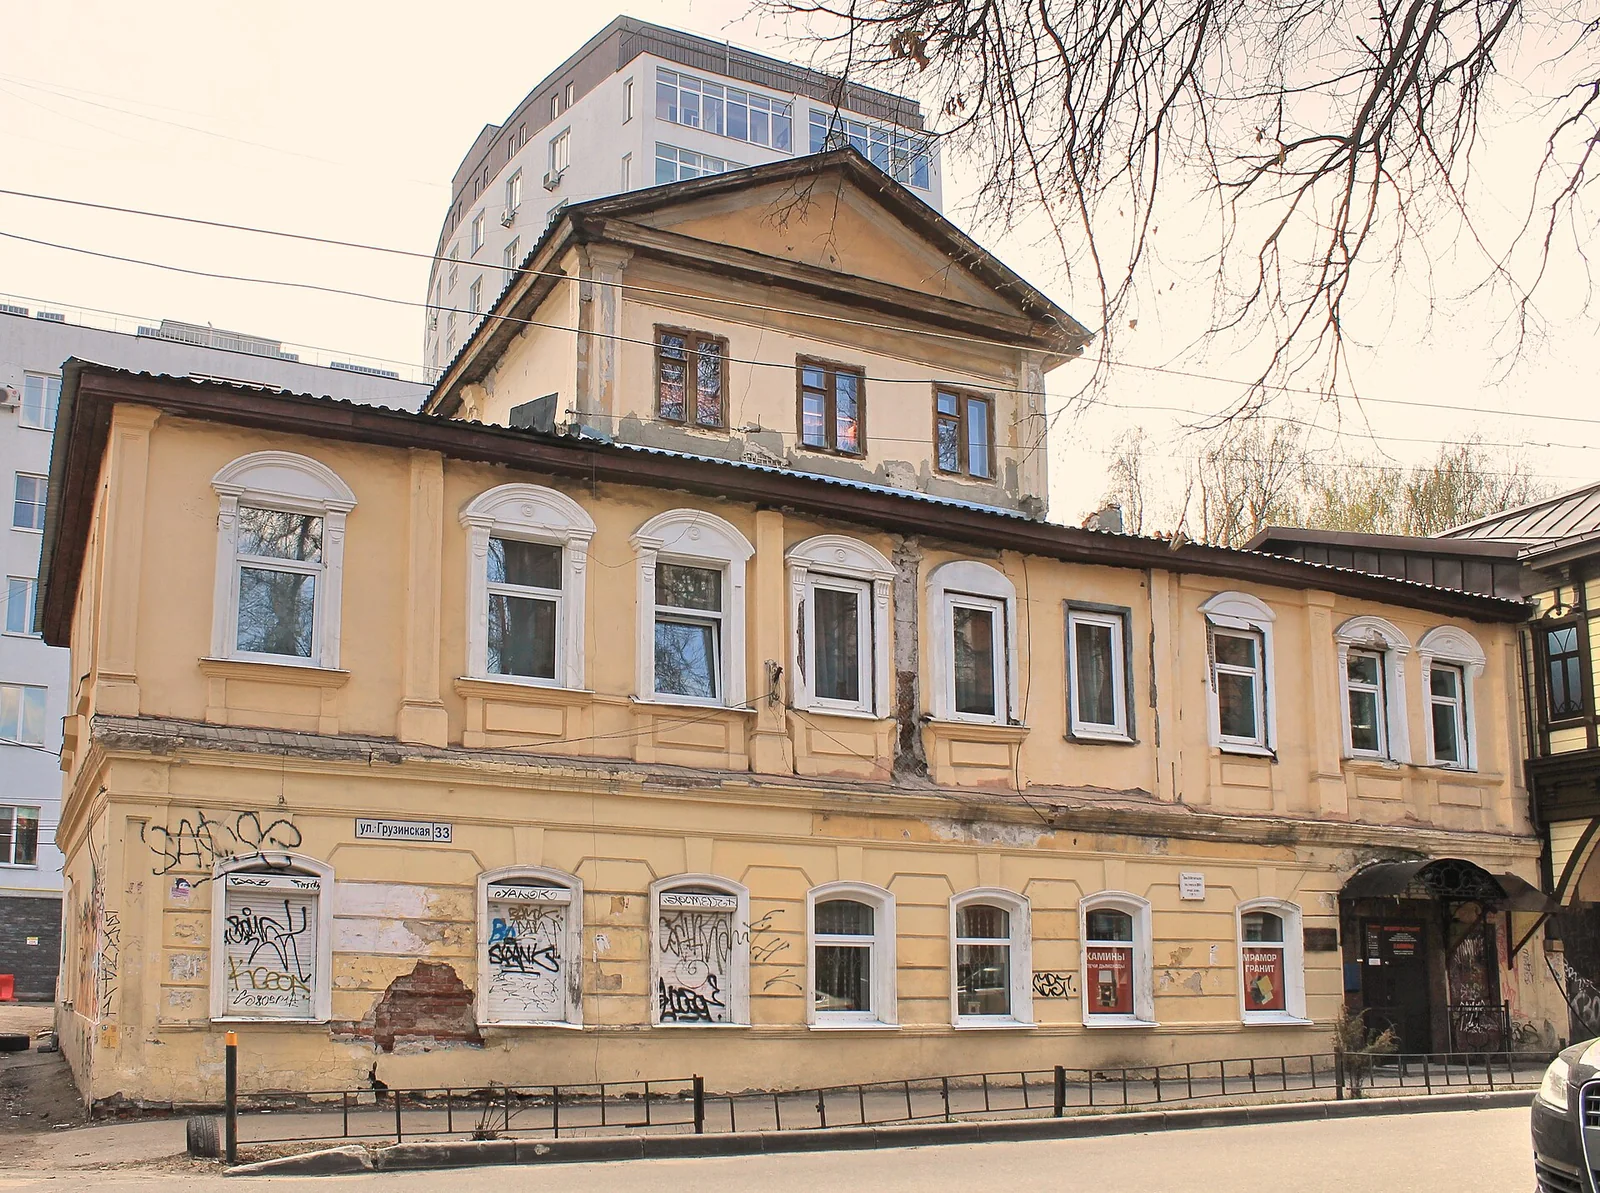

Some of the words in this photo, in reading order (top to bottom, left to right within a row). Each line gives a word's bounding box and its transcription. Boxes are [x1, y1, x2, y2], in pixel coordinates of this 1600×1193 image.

[377, 822, 430, 837] Грузинская
[434, 827, 450, 838] 33
[1087, 952, 1125, 961] КАМИНЫ
[1243, 953, 1277, 961] МРАМОР
[1245, 964, 1275, 973] ГРАНИТ
